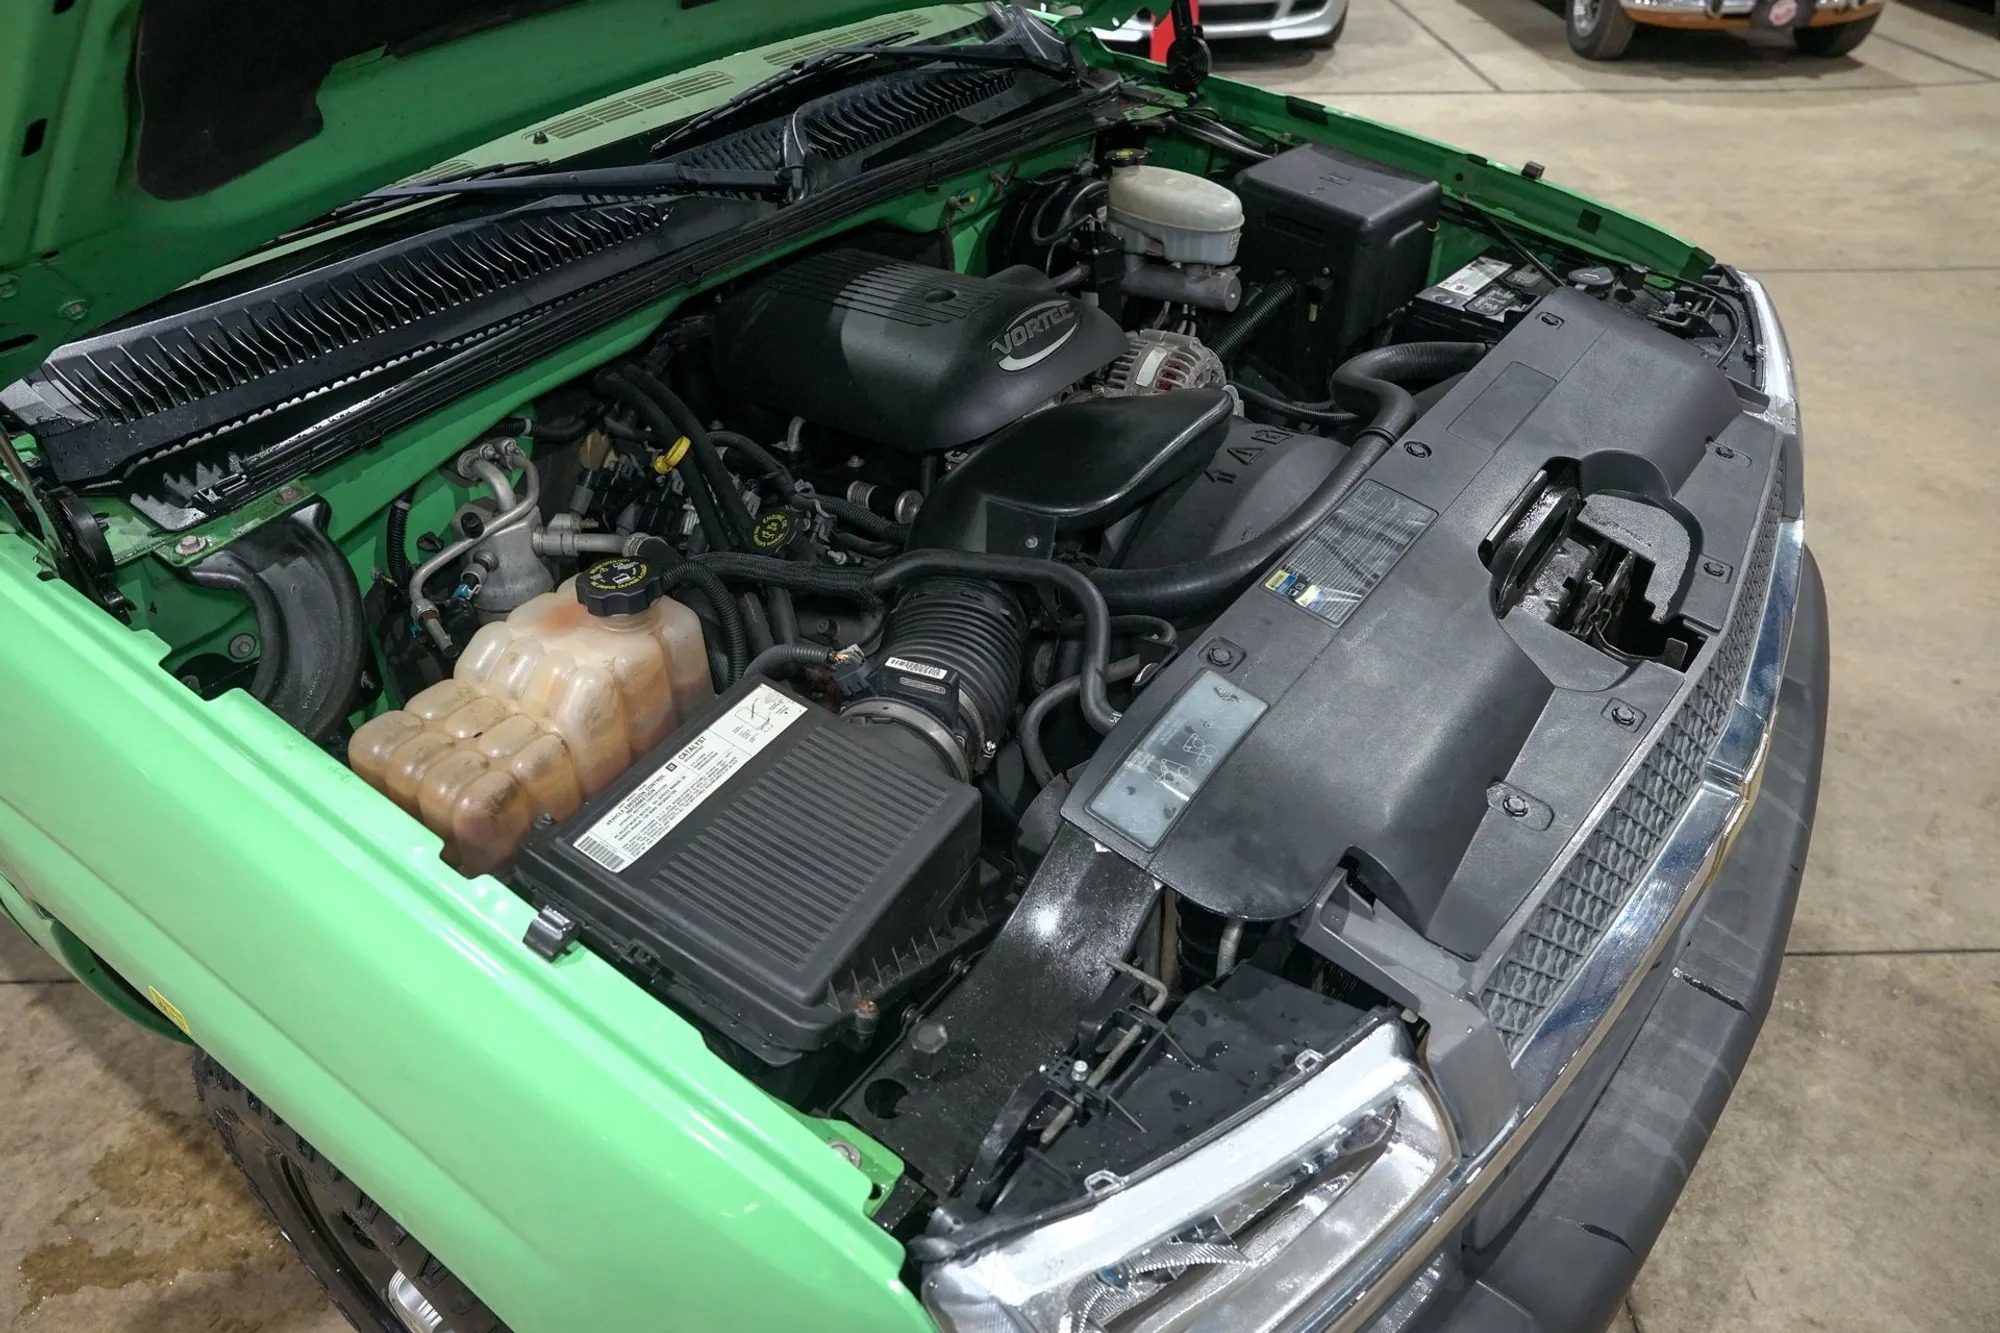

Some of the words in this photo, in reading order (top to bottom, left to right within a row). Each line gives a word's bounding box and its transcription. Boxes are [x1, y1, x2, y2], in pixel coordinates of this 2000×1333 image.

[991, 304, 1074, 354] VORTEC
[678, 736, 707, 760] CATALYST
[624, 791, 646, 809] EMISSION
[645, 775, 666, 791] CONTROL
[625, 788, 656, 815] INFORMATION
